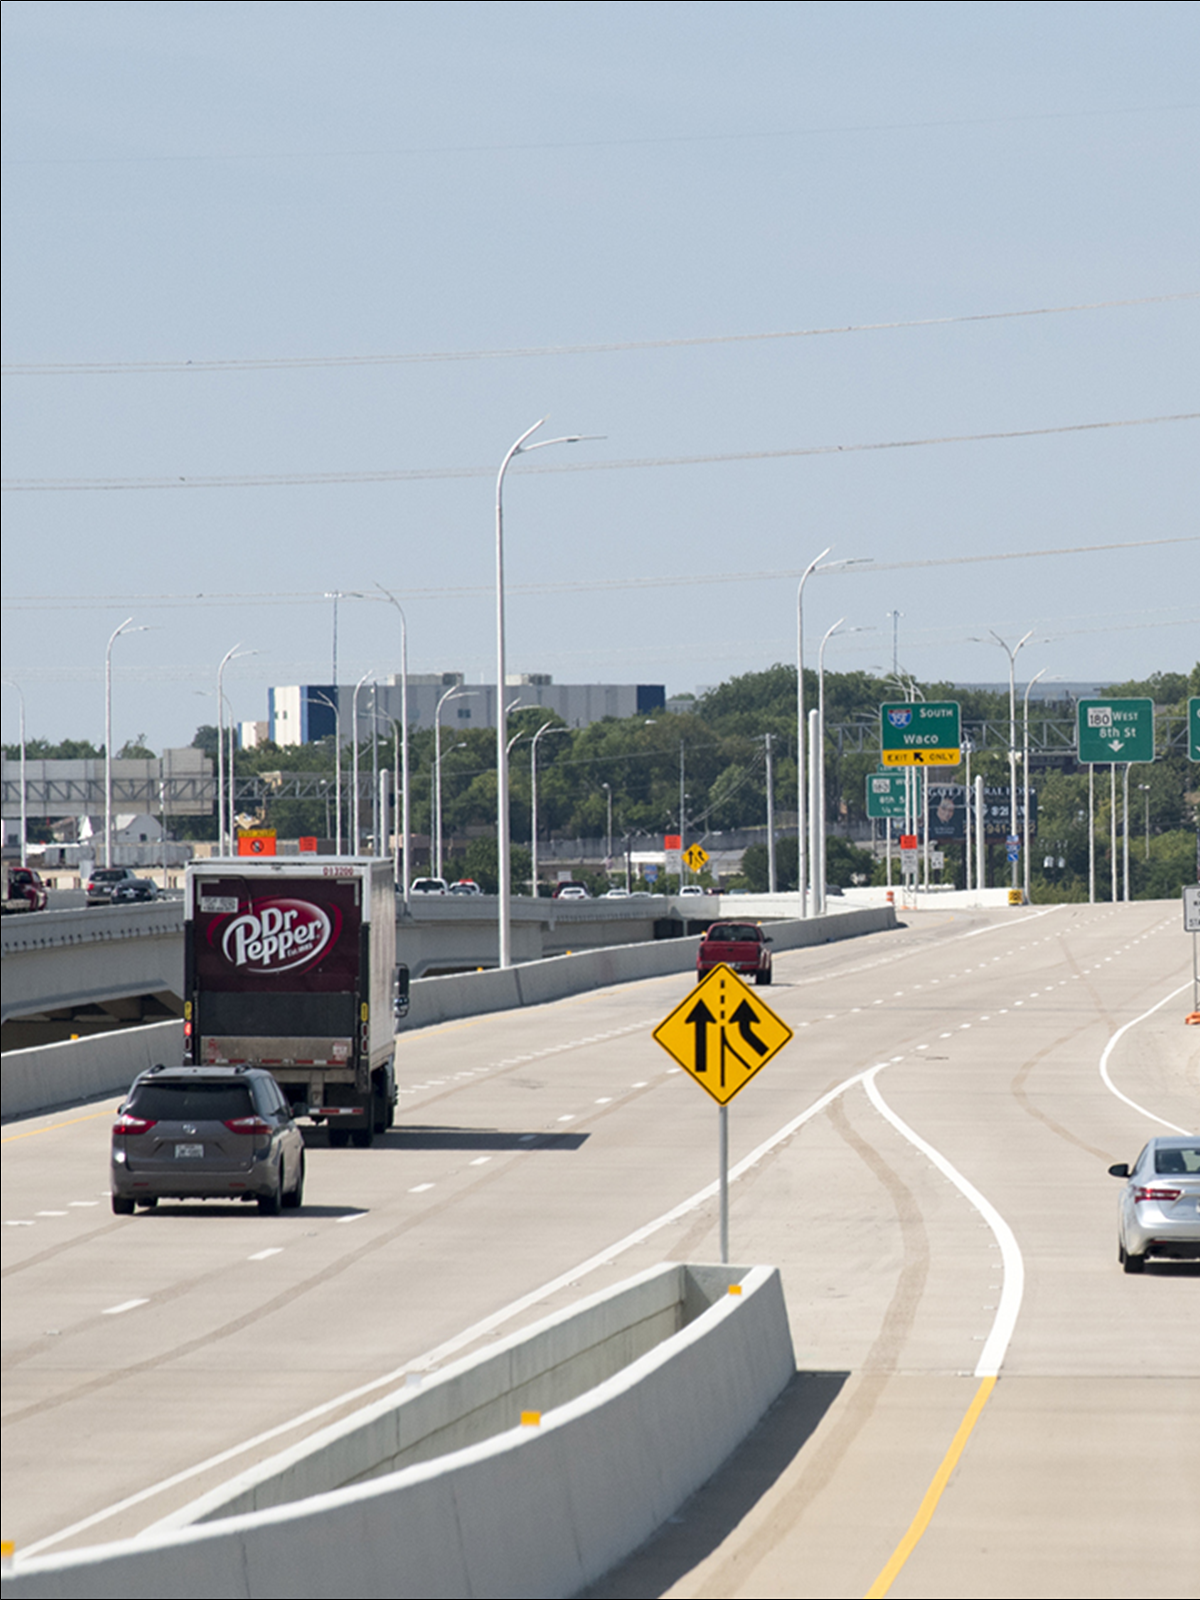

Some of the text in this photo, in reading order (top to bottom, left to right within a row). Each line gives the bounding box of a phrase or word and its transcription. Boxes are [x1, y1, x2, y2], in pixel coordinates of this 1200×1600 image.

[1089, 713, 1110, 725] 180
[1099, 727, 1136, 738] 8th St
[903, 734, 939, 744] Waco
[887, 753, 955, 762] EXIT ONLY
[260, 907, 298, 938] Dr
[226, 914, 322, 967] Pepper
